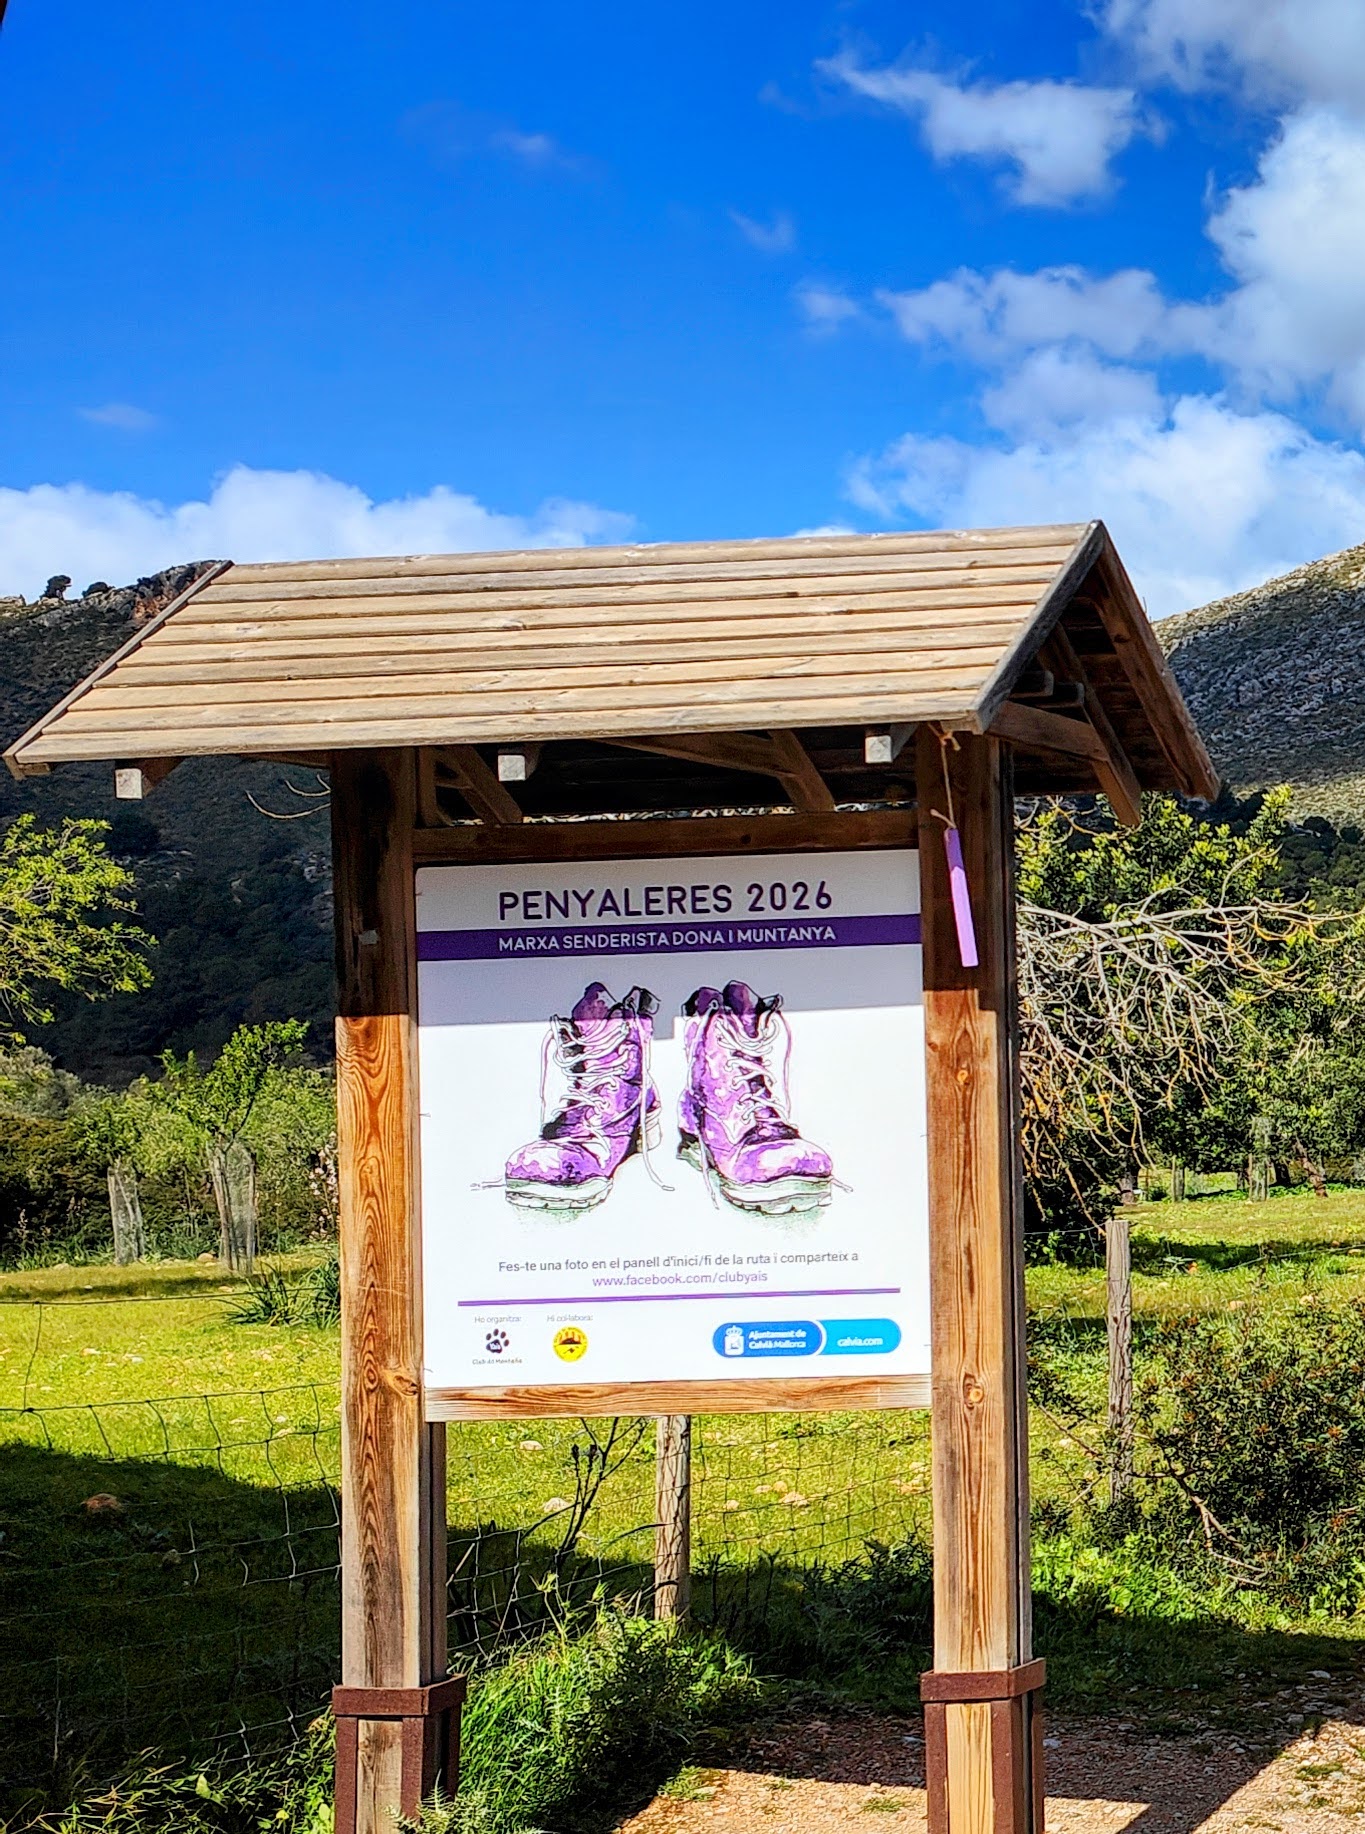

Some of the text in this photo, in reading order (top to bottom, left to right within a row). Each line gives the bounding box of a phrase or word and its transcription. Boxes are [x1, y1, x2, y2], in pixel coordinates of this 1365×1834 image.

[499, 880, 833, 921] PENYALERES 2026
[499, 925, 836, 952] MARXA SENDERISTA DONA I MUNTANYA
[498, 1261, 537, 1272] Fes-te
[540, 1262, 562, 1271] una
[565, 1259, 589, 1270] foto
[592, 1260, 606, 1270] en
[610, 1258, 620, 1269] el
[623, 1256, 660, 1270] panell
[715, 1254, 730, 1266] de
[732, 1253, 743, 1265] la
[746, 1254, 770, 1264] ruta
[780, 1250, 849, 1266] comparteix
[851, 1252, 859, 1261] a
[592, 1270, 768, 1286] www.facebook.com/clubyais
